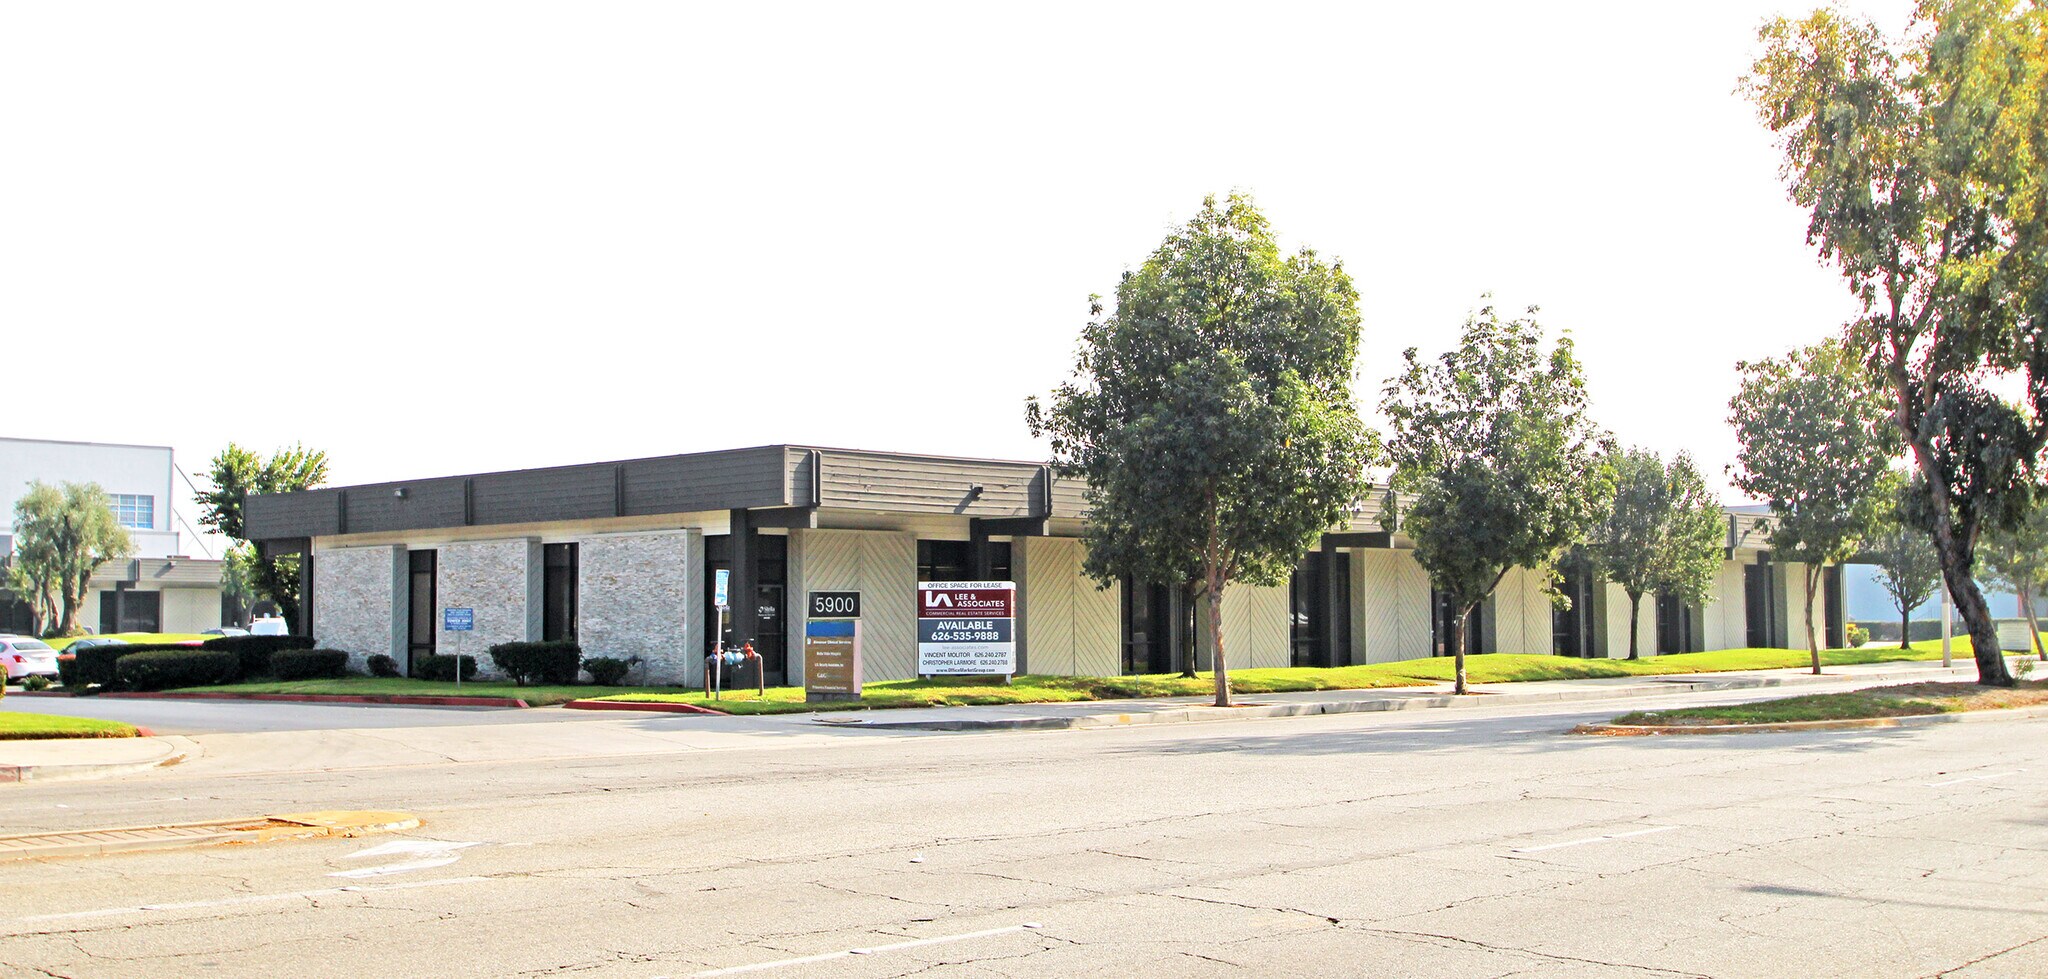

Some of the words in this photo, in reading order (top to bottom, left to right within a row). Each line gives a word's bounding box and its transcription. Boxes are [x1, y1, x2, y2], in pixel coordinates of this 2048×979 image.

[815, 597, 854, 613] 5900
[937, 621, 993, 630] AVAILABLE
[931, 631, 999, 641] 626-535-9888
